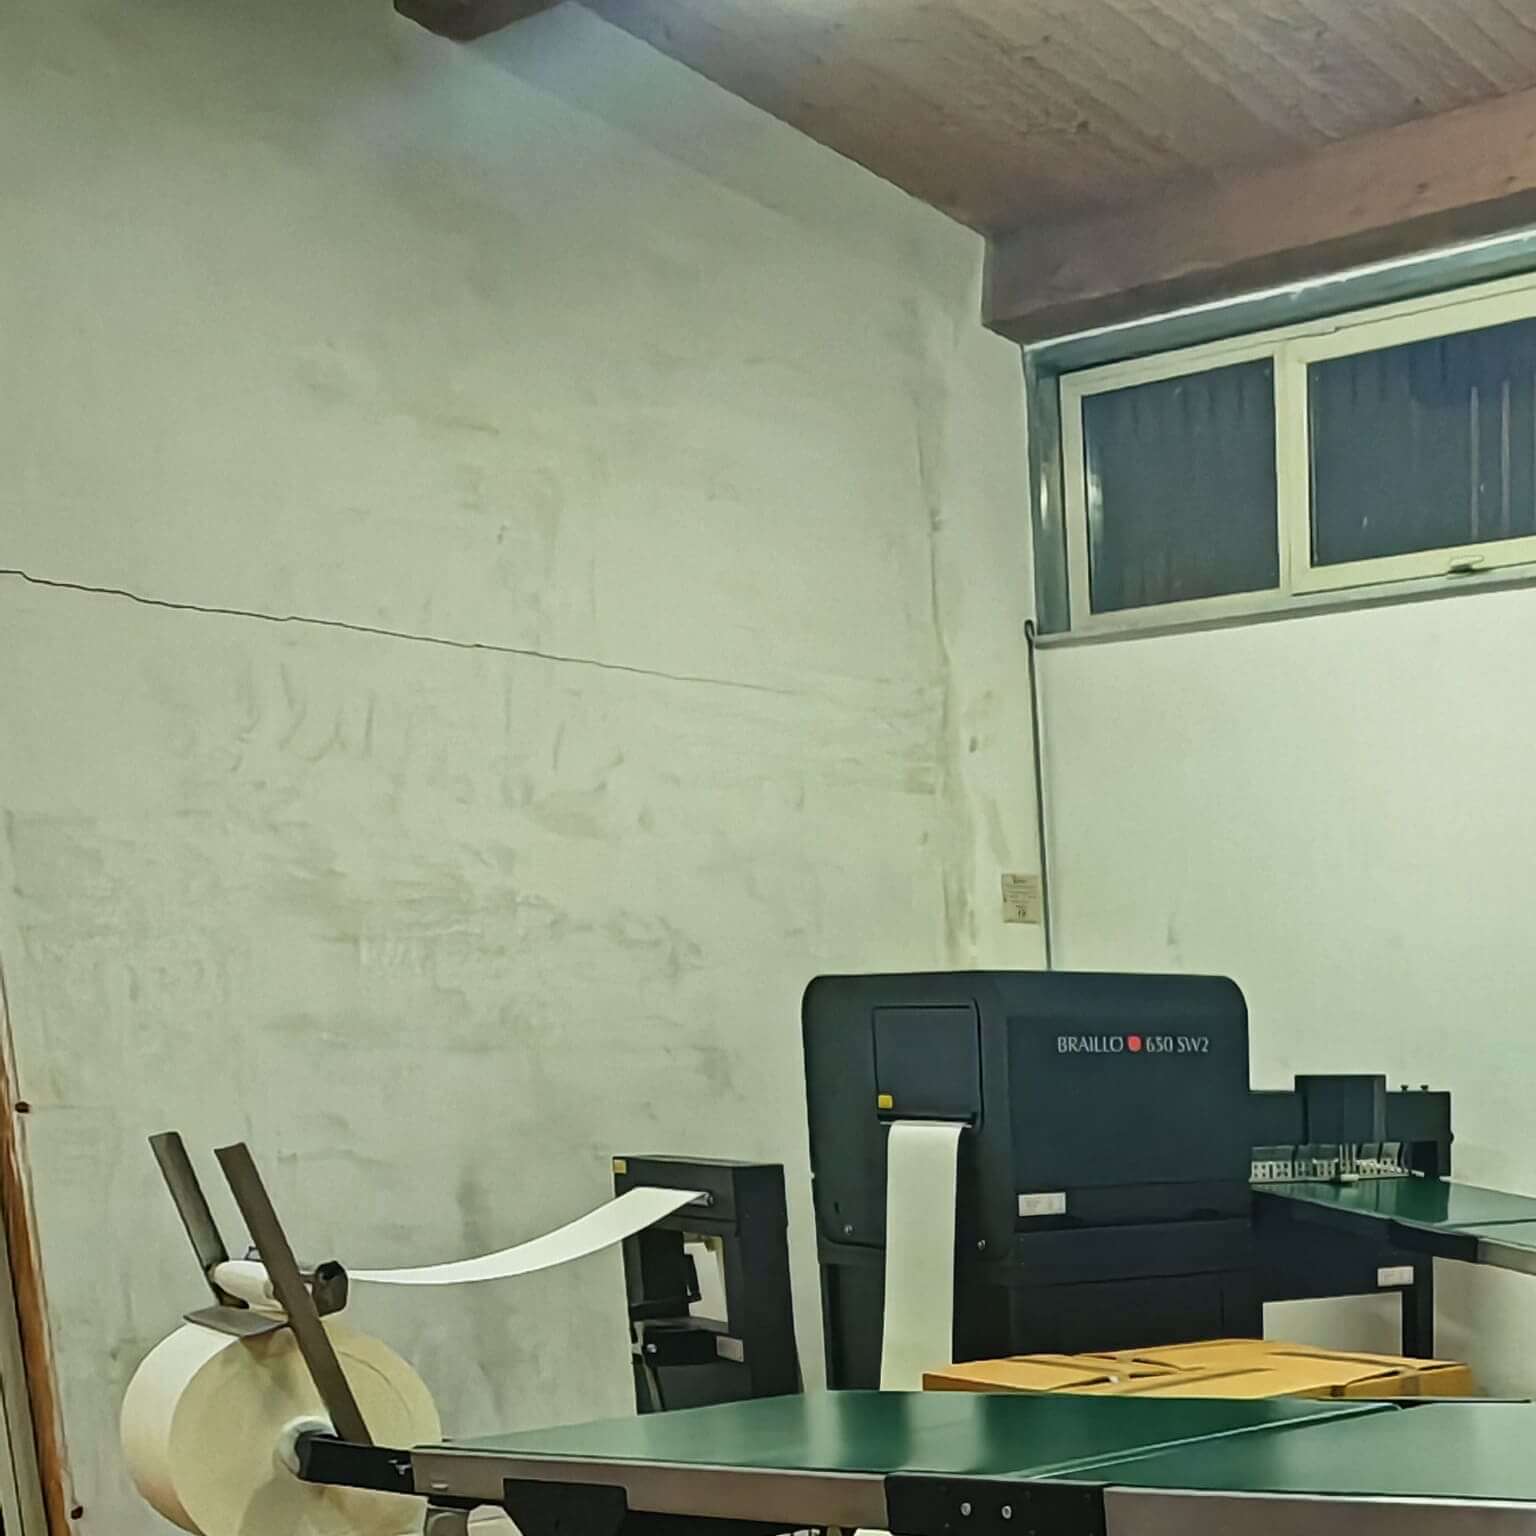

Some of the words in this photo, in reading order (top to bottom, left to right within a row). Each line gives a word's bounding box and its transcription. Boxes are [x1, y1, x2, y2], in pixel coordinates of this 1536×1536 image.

[1057, 1035, 1124, 1053] BRAILLO
[1146, 1036, 1174, 1053] 650
[1177, 1036, 1209, 1053] SW2
